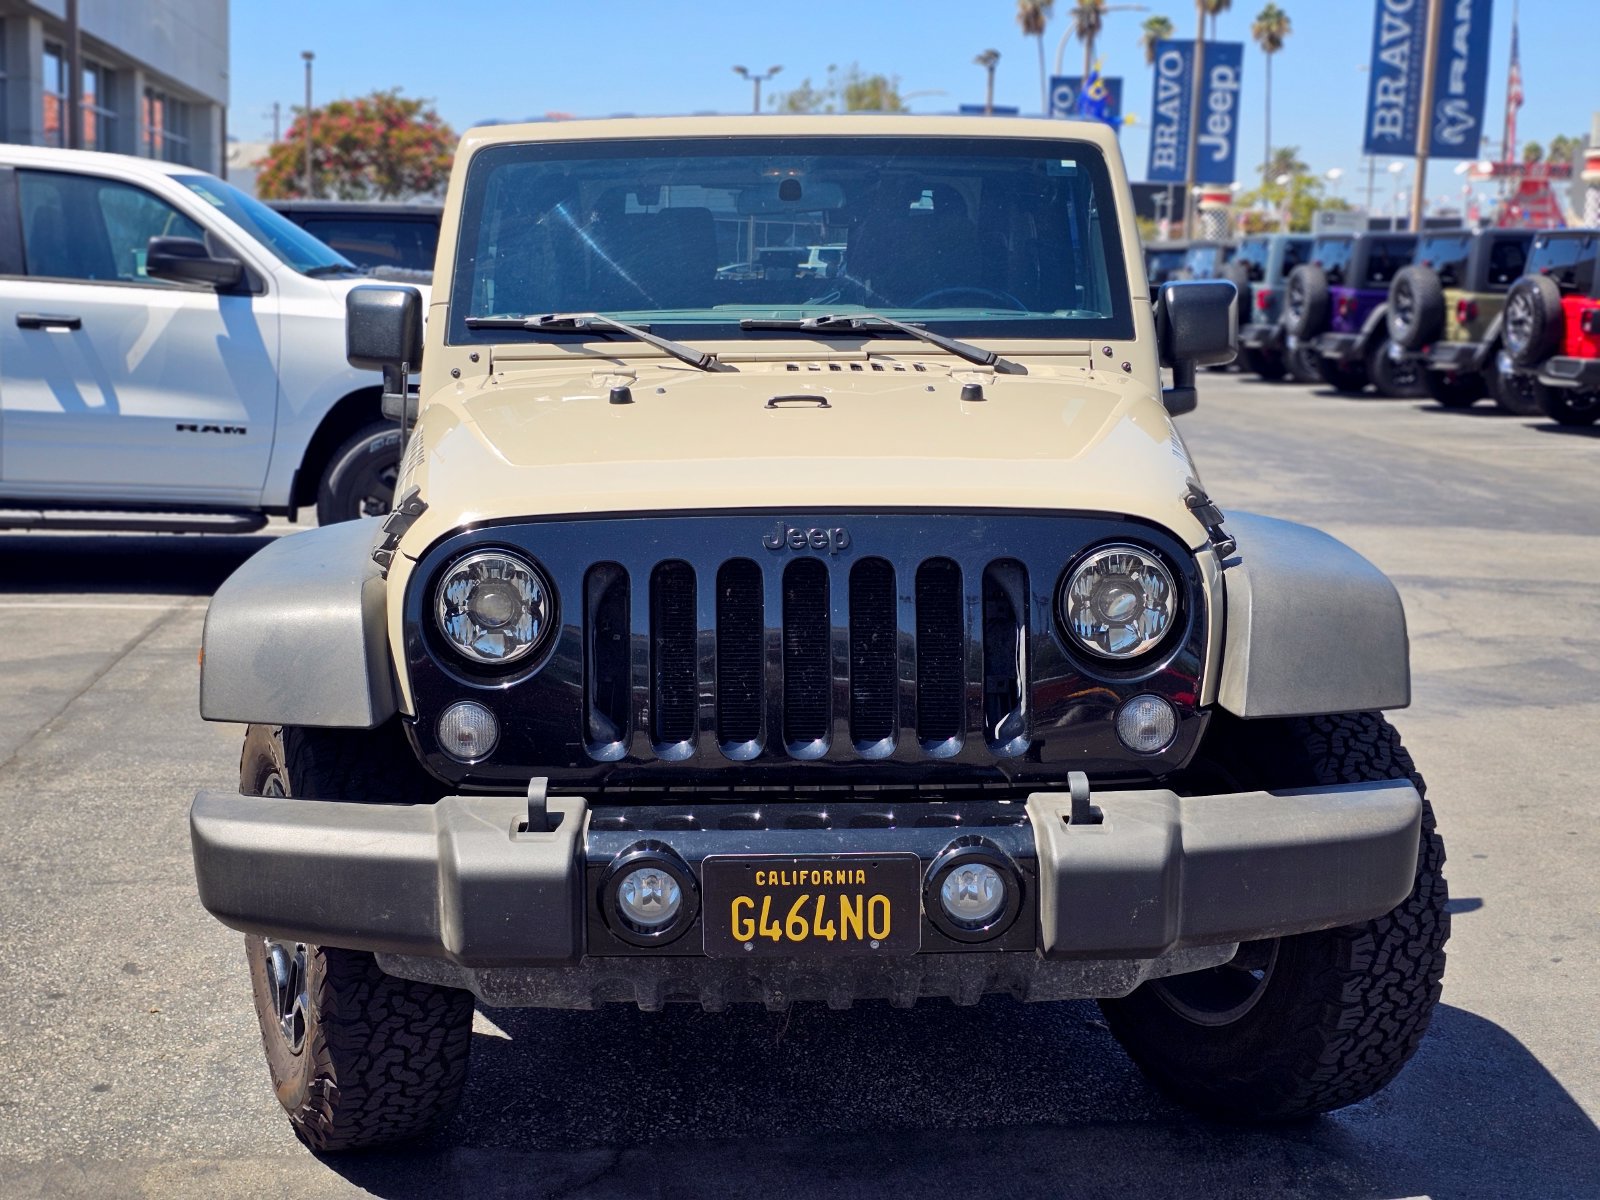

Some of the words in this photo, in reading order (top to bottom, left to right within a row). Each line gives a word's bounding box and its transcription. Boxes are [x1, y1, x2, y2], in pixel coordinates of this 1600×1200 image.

[1153, 50, 1184, 171] BRAVO
[1198, 64, 1240, 162] Jeep
[175, 424, 247, 435] RAM
[762, 520, 850, 556] Jeep
[755, 869, 867, 886] CALIFORNIA
